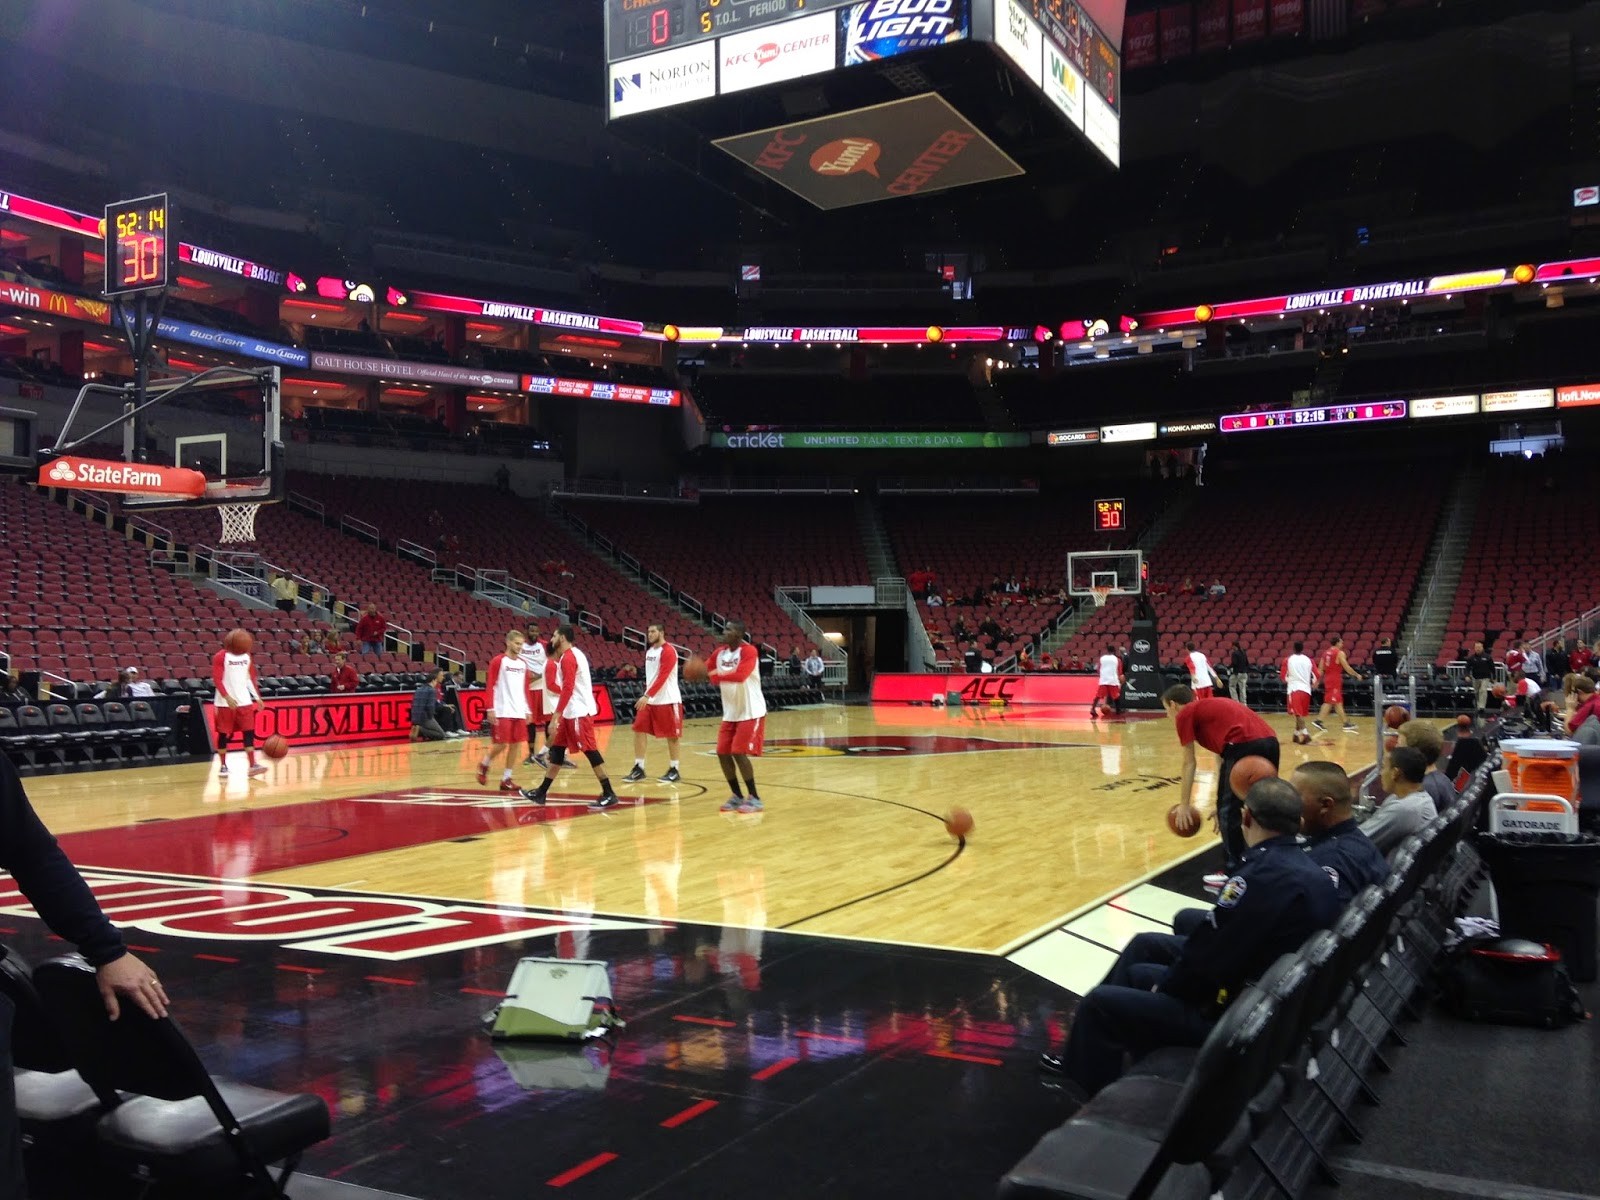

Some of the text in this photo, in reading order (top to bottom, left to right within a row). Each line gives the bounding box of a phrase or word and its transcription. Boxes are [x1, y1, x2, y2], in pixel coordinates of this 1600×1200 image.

[750, 0, 786, 18] PERIOD
[868, 0, 951, 21] BUD
[701, 11, 712, 33] 5
[855, 16, 954, 45] LIGHT
[725, 52, 751, 67] KFC
[783, 34, 830, 54] CENTER
[649, 59, 711, 85] NORTON
[754, 128, 977, 195] KFC Yum! CENTER
[116, 208, 164, 239] 52:14
[124, 236, 157, 284] 30
[191, 248, 245, 275] LOUISVILLE
[1285, 280, 1425, 310] LOUISVILLE BASKETBALL
[481, 303, 600, 330] LOUISVILLE BASKETBALL
[189, 329, 246, 349] BUD LIGHT
[743, 329, 859, 341] LOUISVILLE BASKETBALL
[255, 344, 306, 363] BUD LIGHT
[314, 355, 343, 369] GALT
[343, 359, 379, 373] HOUSE
[380, 363, 414, 376] HOTEL
[416, 368, 437, 377] Official
[437, 370, 453, 379] Hotel
[531, 377, 548, 386] WAVE
[531, 385, 551, 393] NEWS
[558, 380, 575, 388] EXPECT
[558, 386, 573, 394] RIGHT
[593, 383, 608, 392] WAVE
[592, 391, 611, 400] NEWS
[618, 387, 635, 395] EXPECT
[651, 389, 666, 398] WAVE
[1295, 409, 1325, 423] 52:15
[1168, 422, 1216, 433] KONICA MINOLTA
[727, 432, 785, 448] cricket
[803, 435, 859, 445] UNLIMITED
[924, 436, 932, 445] &
[934, 435, 964, 445] DATA
[1098, 502, 1122, 512] 52:14
[1102, 511, 1120, 527] 30
[1139, 664, 1154, 672] PNC
[960, 677, 1020, 700] ACC
[248, 700, 412, 740] OUISVILLE
[1501, 820, 1560, 830] GATORADE
